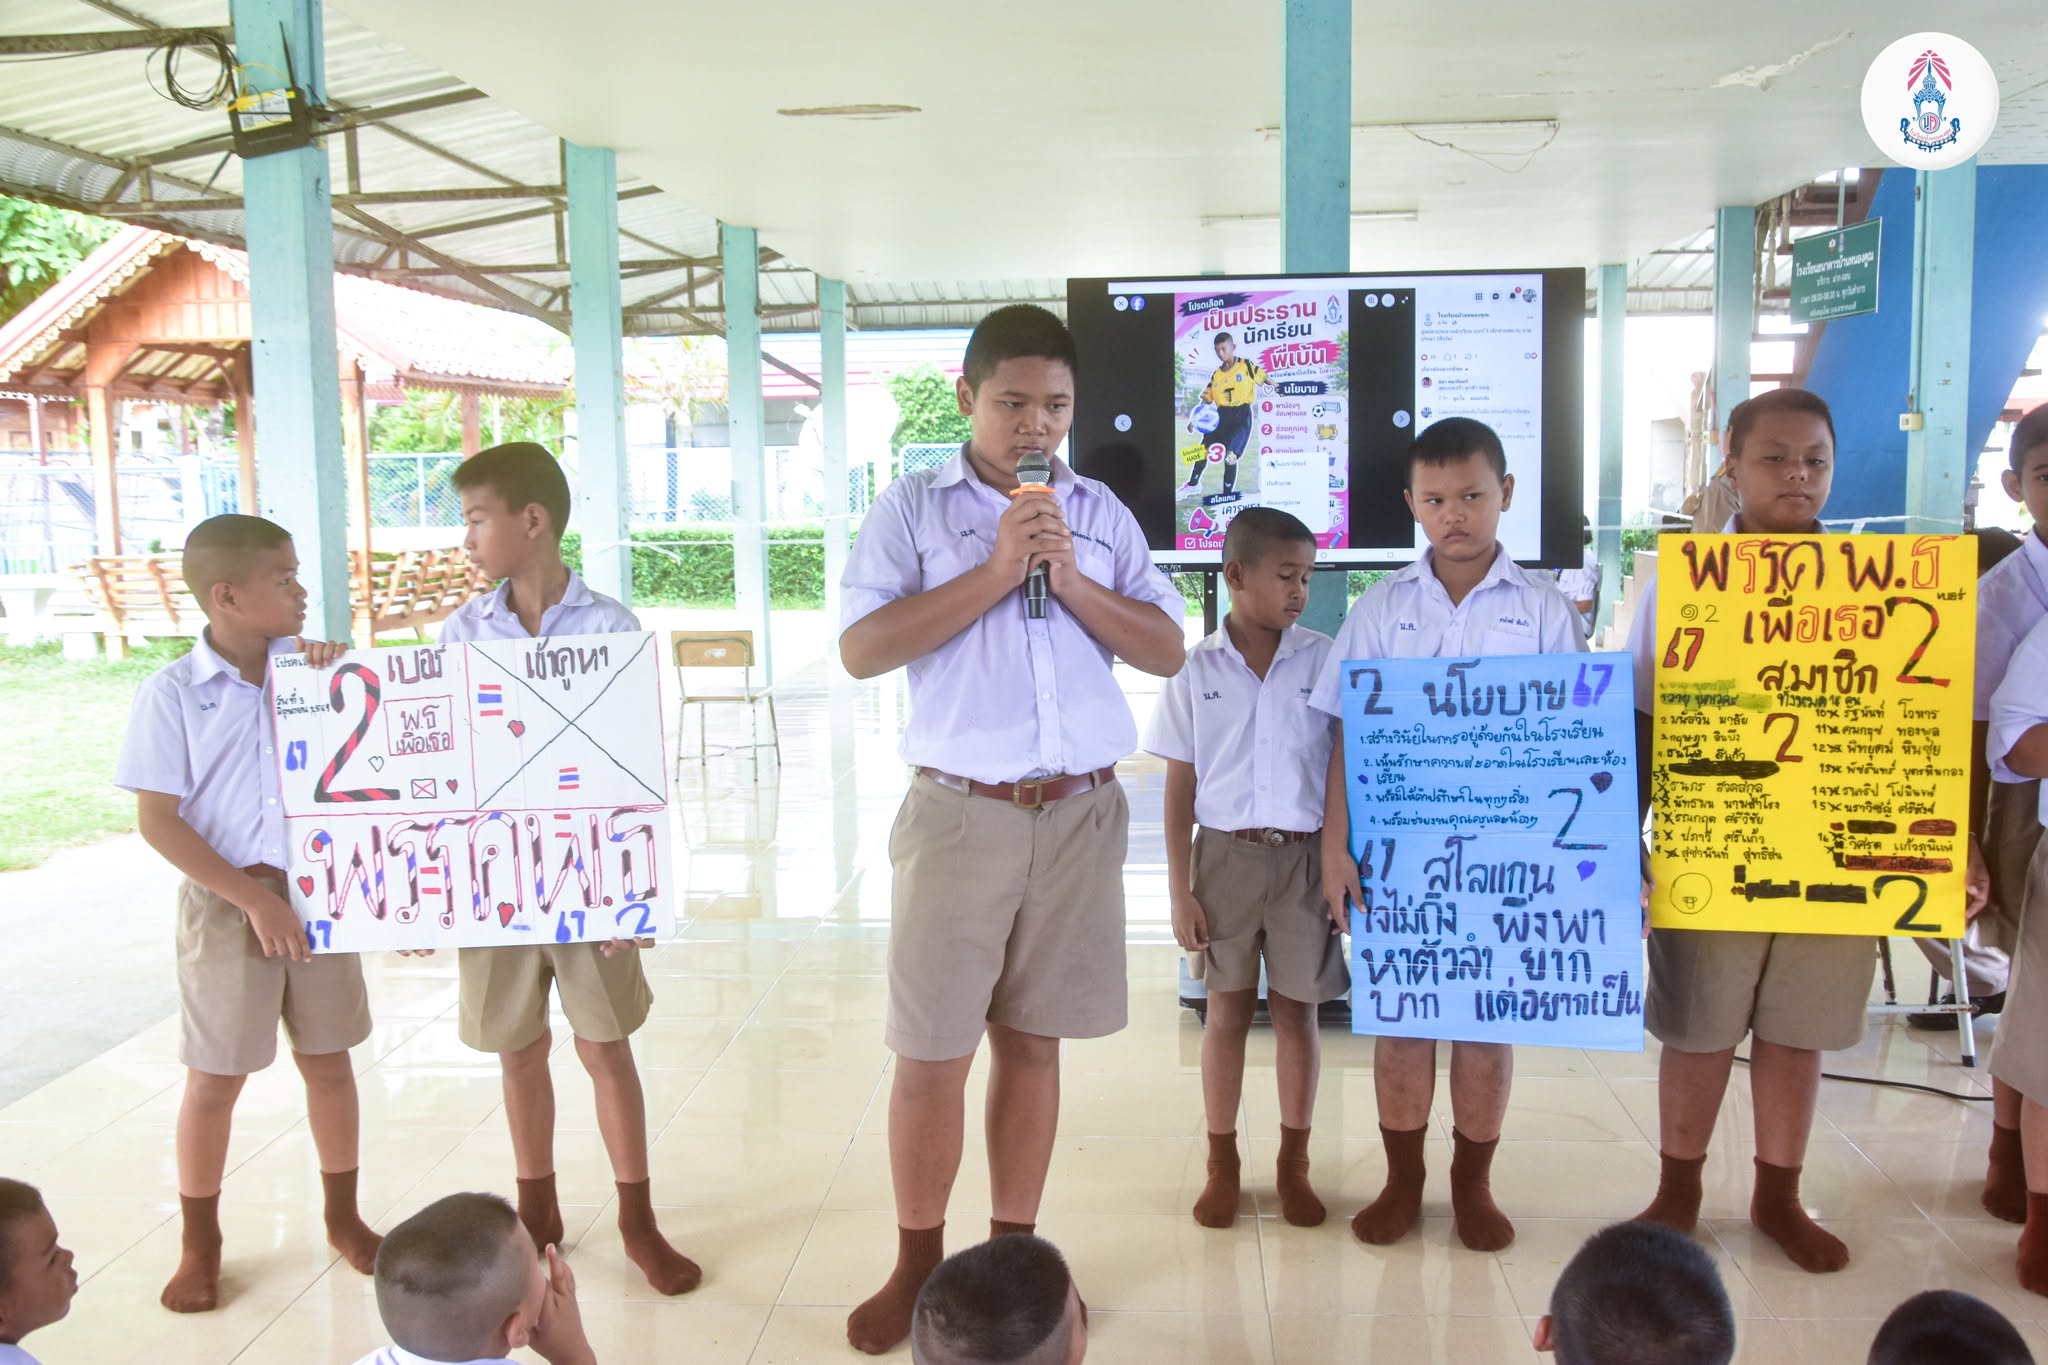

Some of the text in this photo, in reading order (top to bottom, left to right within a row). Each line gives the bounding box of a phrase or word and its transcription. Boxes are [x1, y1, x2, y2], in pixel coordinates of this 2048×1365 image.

[1188, 298, 1224, 312] โปรดเลือก
[1203, 301, 1317, 332] เป็นประธาน
[1243, 321, 1312, 344] นักเรียน
[1272, 343, 1327, 370] พี่เบ้น
[1284, 381, 1318, 395] นโยบาย
[1208, 445, 1224, 463] 3
[1210, 494, 1236, 504] สโลแกน
[1681, 535, 1960, 594] พรรค พ.ธ
[1743, 589, 1951, 688] เพื่อเธอ 2
[388, 636, 609, 691] เบอร์ เข้าคูหา
[1757, 648, 1878, 694] สมาชิก
[1349, 658, 1614, 718] 2 นโยบาย 67
[1776, 685, 1827, 708] ทั้งหมด
[1719, 713, 1748, 725] มาลัย
[1898, 698, 1940, 719] โวหาร
[314, 662, 400, 802] 2
[1763, 713, 1803, 762] 2
[1376, 769, 1406, 785] เรียน
[1548, 787, 1609, 850] 2
[1424, 834, 1555, 895] สโลแกน
[615, 902, 657, 935] 2
[1873, 875, 1942, 932] 2
[1520, 947, 1592, 984] ยาก
[1370, 970, 1641, 1023] บาก แต่อยากเป็น
